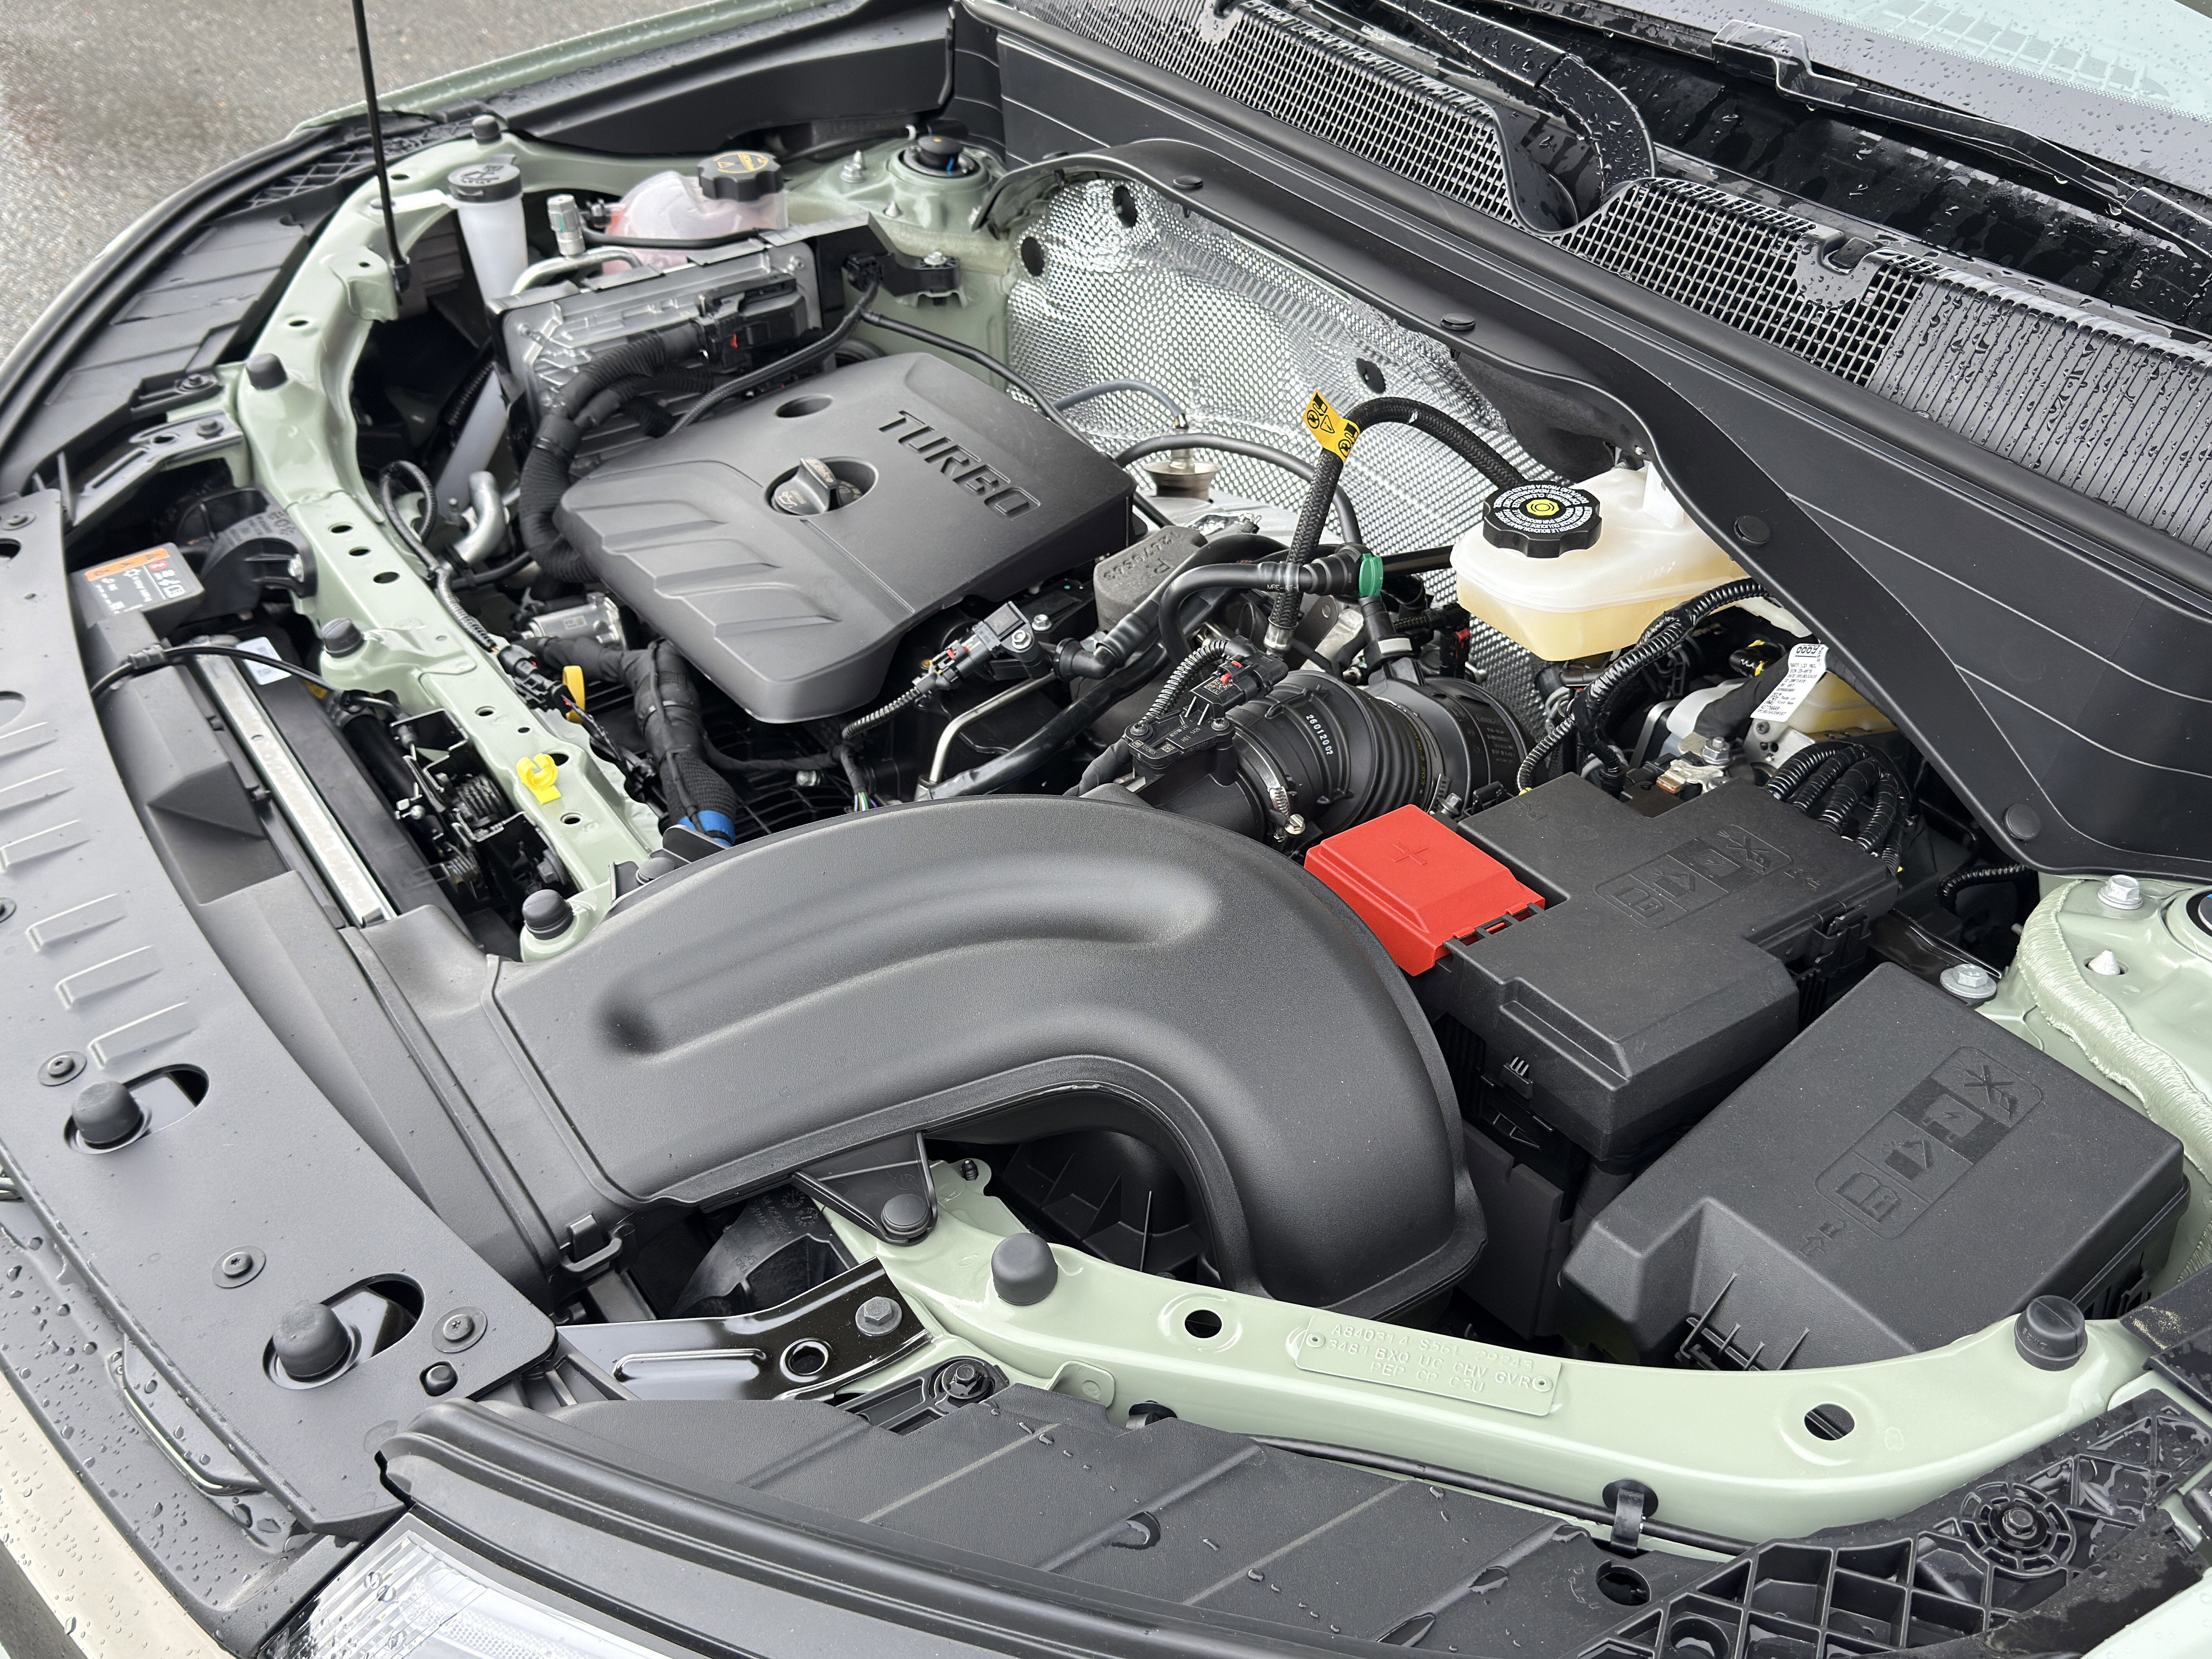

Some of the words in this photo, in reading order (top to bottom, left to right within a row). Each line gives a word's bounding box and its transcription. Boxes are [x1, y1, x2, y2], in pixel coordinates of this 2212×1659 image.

[879, 410, 1041, 521] TURBO
[1549, 489, 1573, 499] BEFORE
[1560, 488, 1578, 496] FLUID
[1506, 522, 1525, 530] AVANT
[1370, 1361, 1405, 1377] PEP
[1416, 1370, 1438, 1382] CP
[1374, 1347, 1410, 1364] BXQ
[1419, 1355, 1444, 1369] UC
[1453, 1362, 1487, 1379] CHV
[1494, 1372, 1530, 1389] GVR
